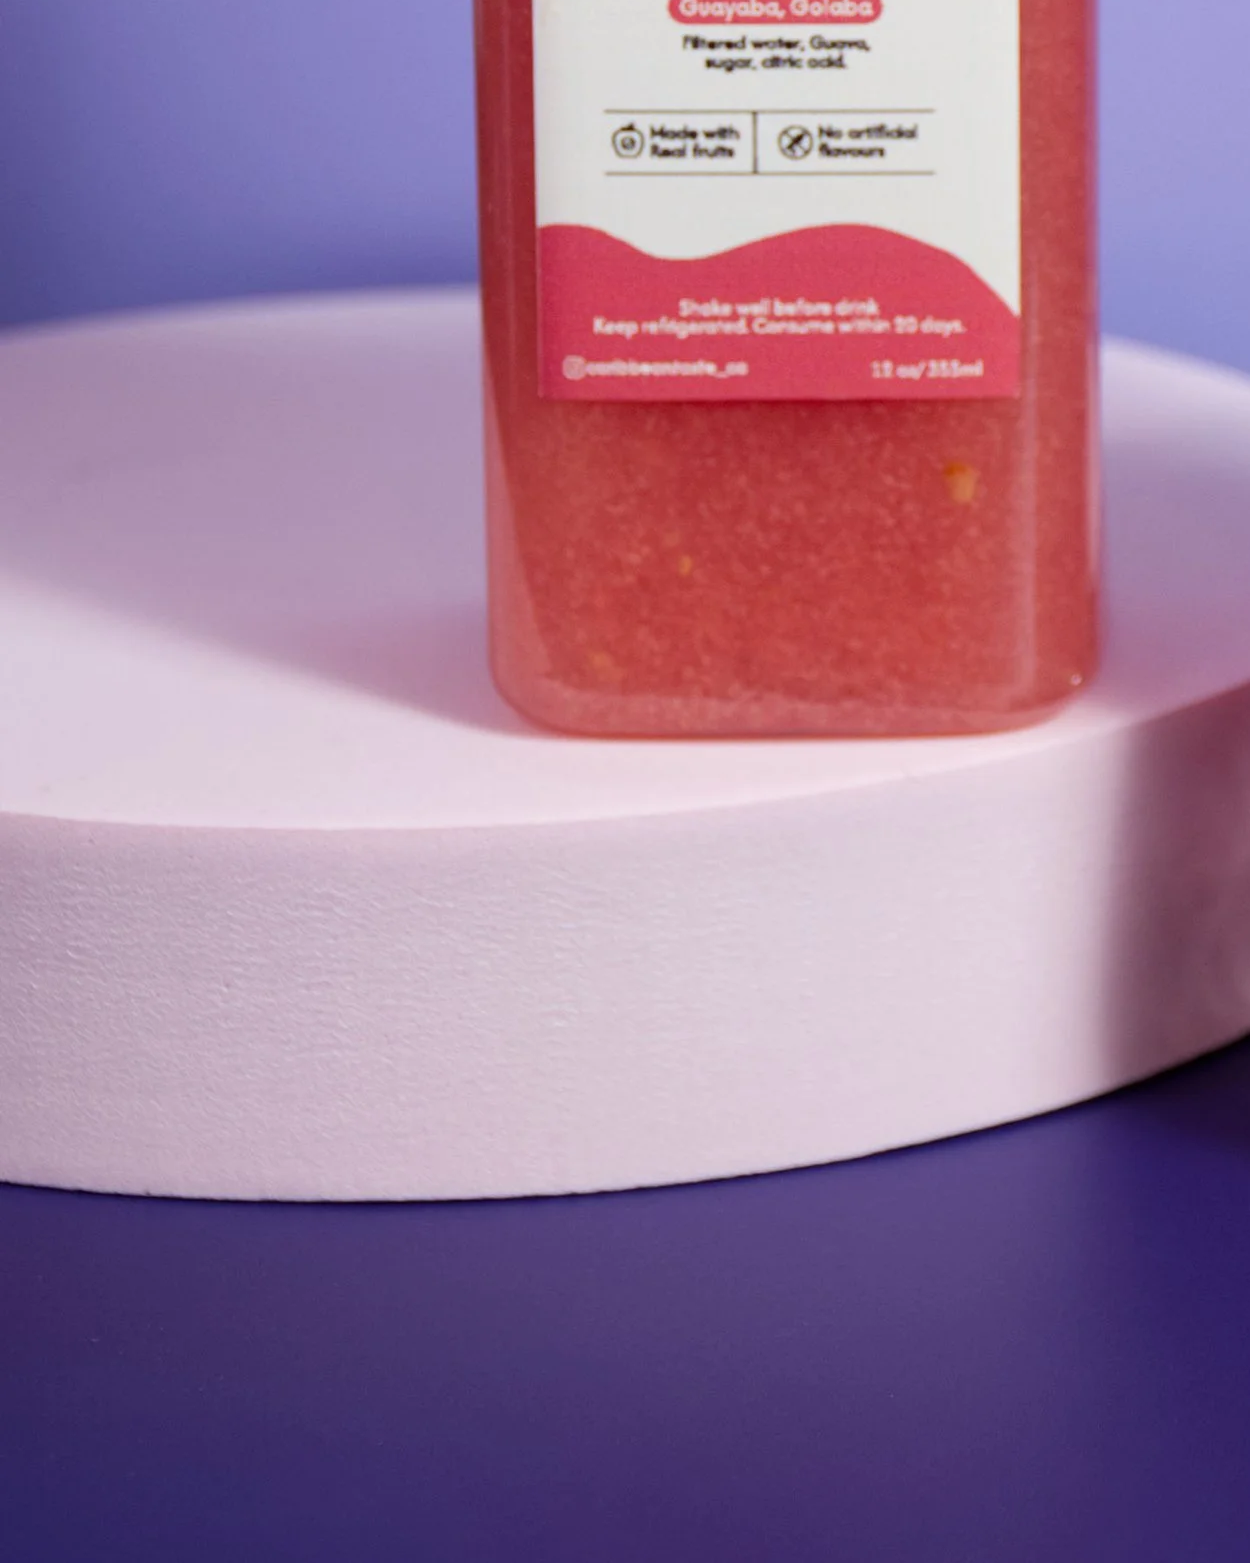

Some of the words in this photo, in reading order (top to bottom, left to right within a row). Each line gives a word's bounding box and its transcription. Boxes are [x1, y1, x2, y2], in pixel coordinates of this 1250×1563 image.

[682, 35, 746, 51] Filtered
[751, 37, 805, 52] water,
[809, 35, 871, 52] Guava,
[705, 57, 757, 73] sugar,
[650, 126, 698, 140] Made
[702, 124, 741, 140] with
[818, 125, 843, 140] No
[848, 124, 916, 139] artificial
[650, 144, 687, 159] Real
[692, 143, 735, 159] fruits
[818, 144, 886, 158] flavours
[679, 298, 732, 317] Shake
[773, 298, 832, 316] before
[593, 317, 639, 338] Keep
[752, 318, 834, 334] Consume
